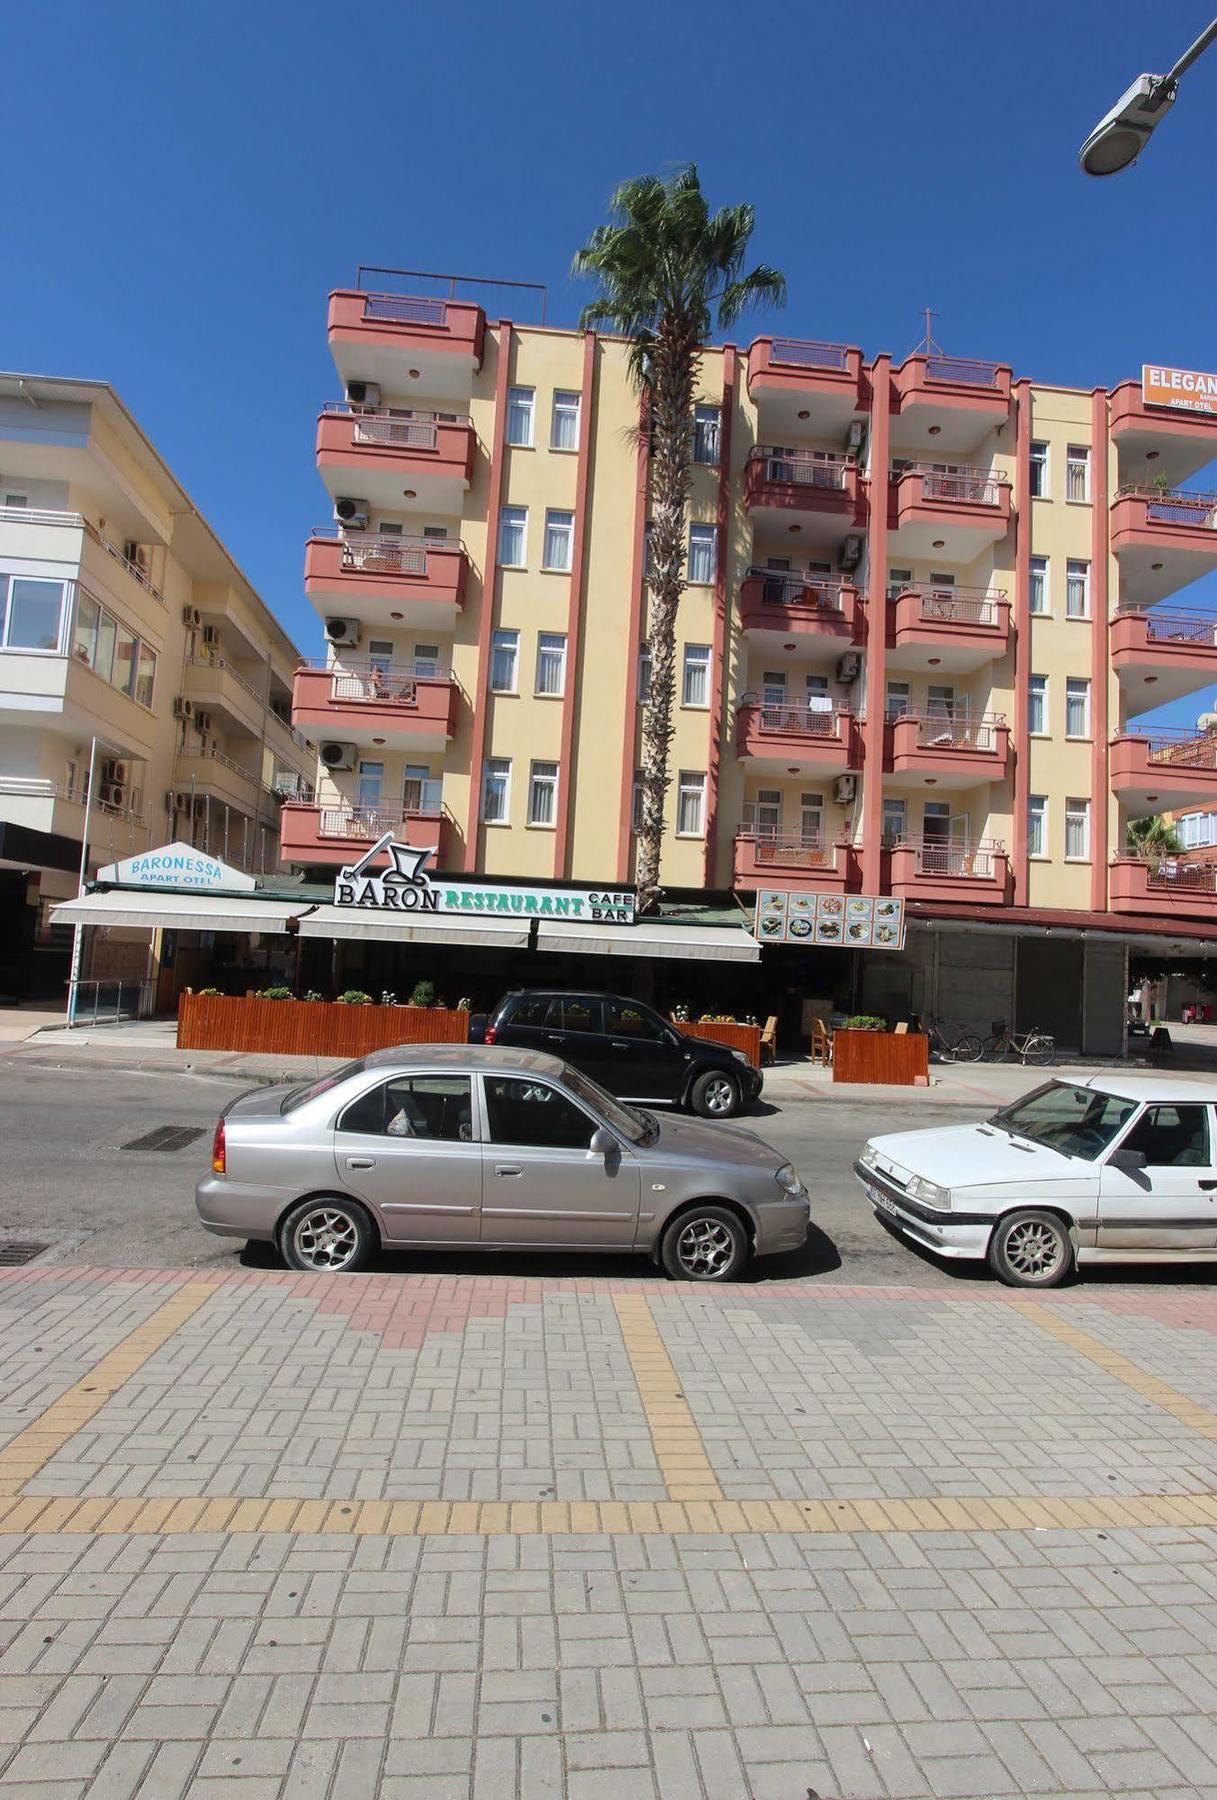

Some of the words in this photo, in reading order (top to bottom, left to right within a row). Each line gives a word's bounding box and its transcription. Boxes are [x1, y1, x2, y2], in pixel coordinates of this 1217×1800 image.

[1170, 398, 1193, 408] APART
[1194, 400, 1213, 410] OTEL
[132, 855, 222, 880] BARONESSA
[140, 873, 180, 883] APART
[183, 876, 213, 885] OTEL
[338, 880, 440, 910] BARON
[444, 890, 585, 917] RESTAURANT
[588, 893, 633, 905] CAFE
[592, 908, 628, 921] BAR
